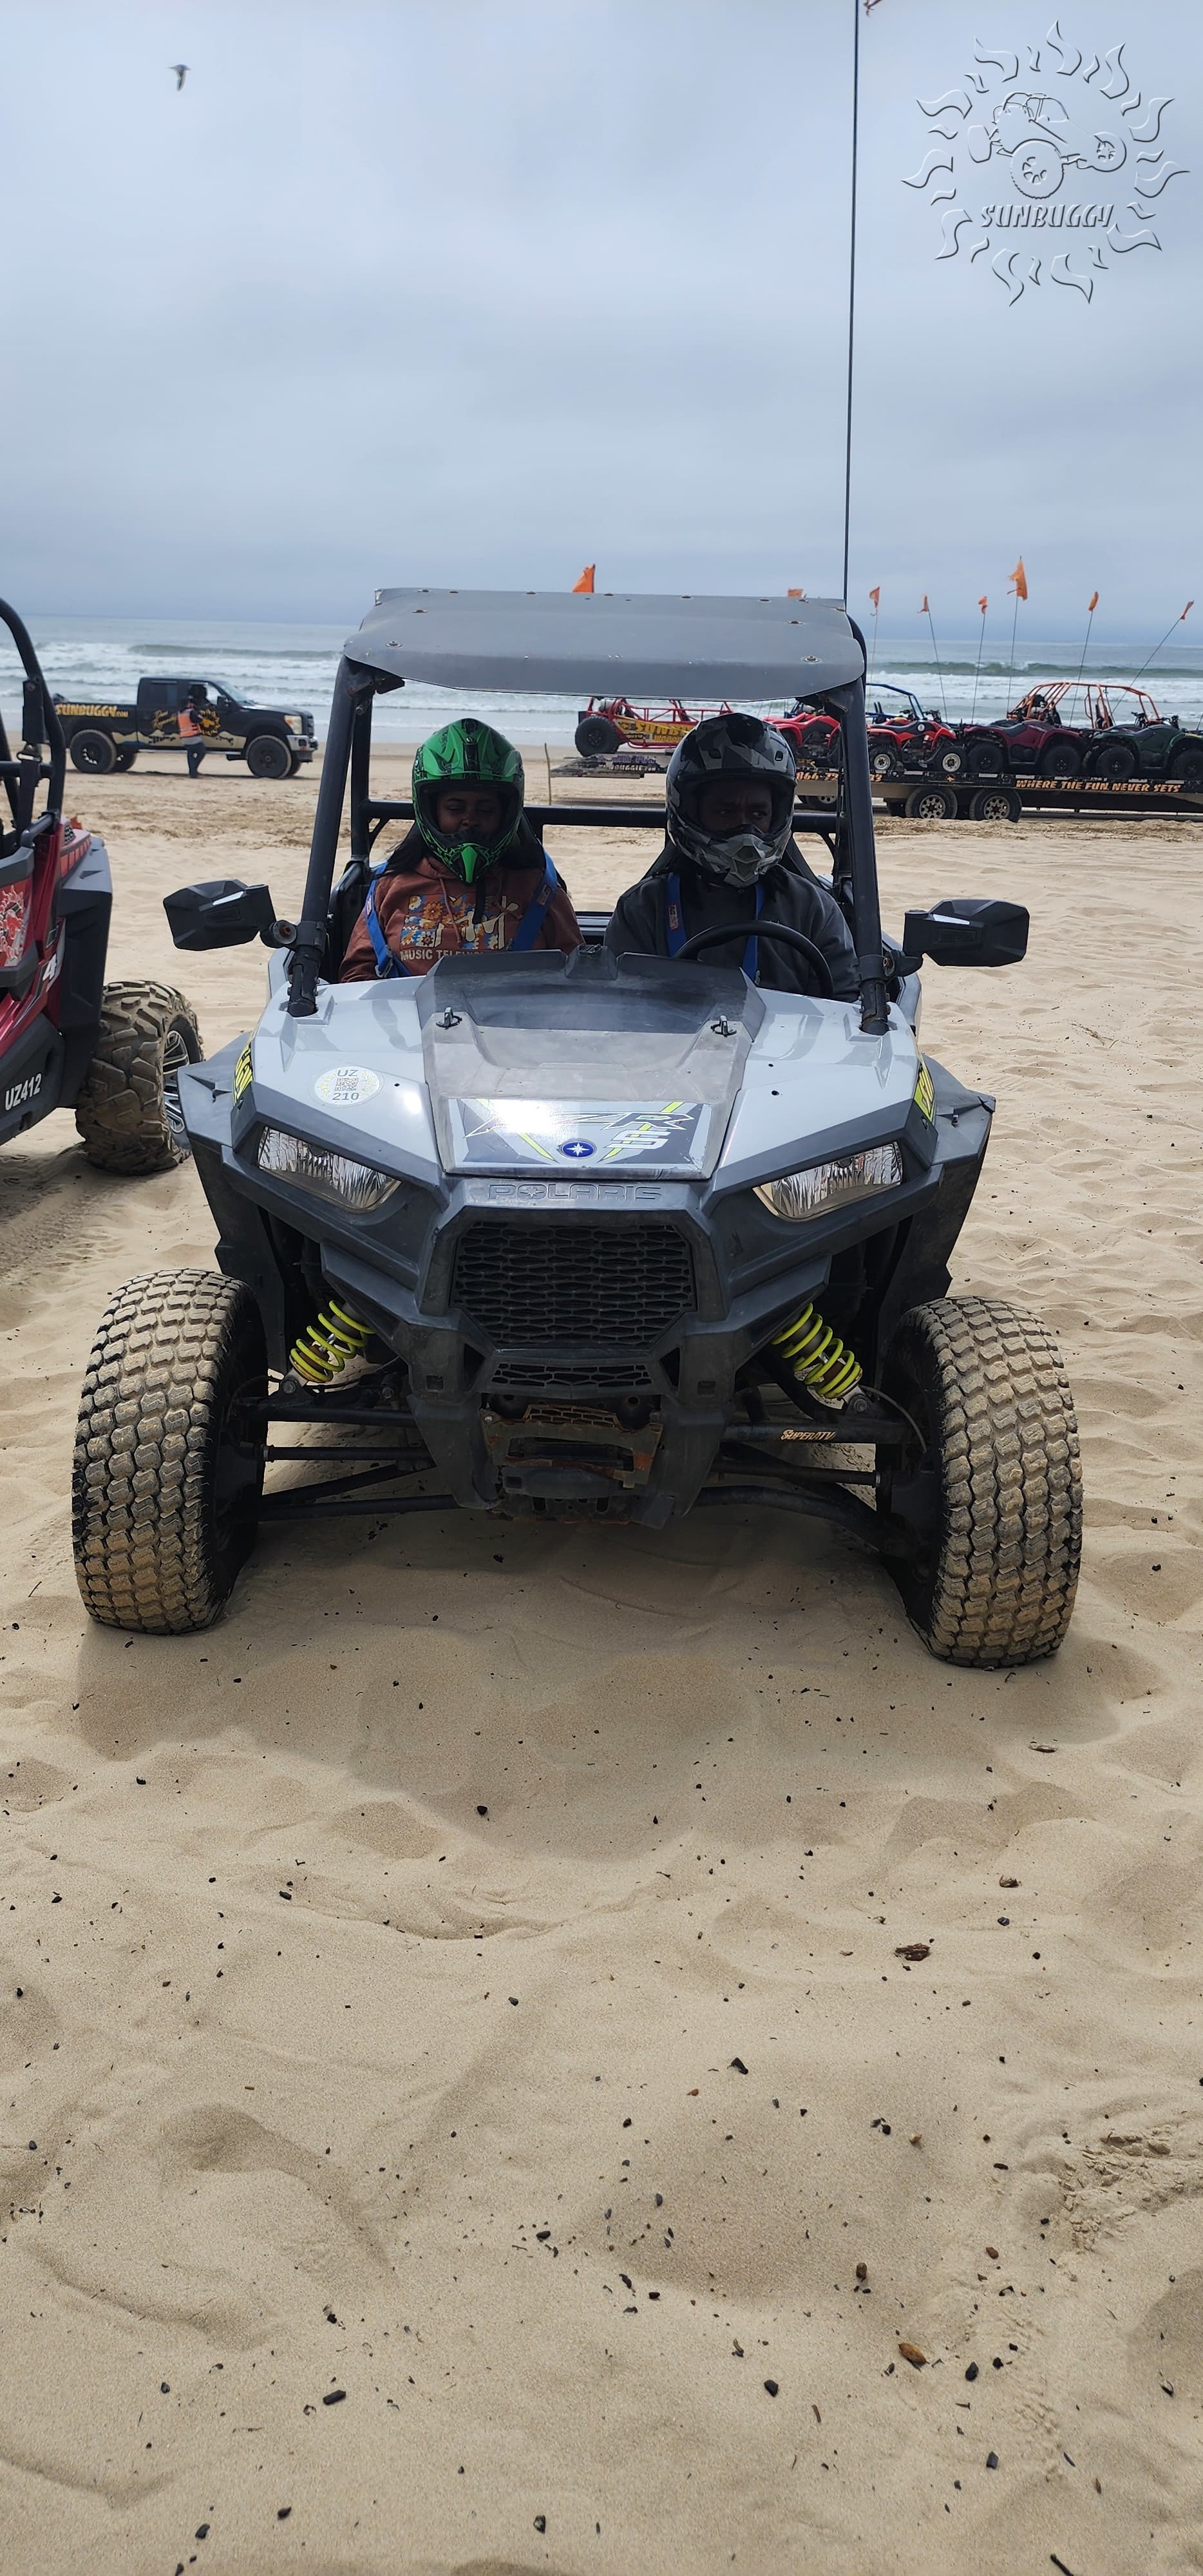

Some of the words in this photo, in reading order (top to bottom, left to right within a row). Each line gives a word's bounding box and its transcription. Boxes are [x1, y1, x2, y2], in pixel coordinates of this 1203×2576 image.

[1016, 779, 1057, 789] WHERE
[1061, 781, 1083, 790] THE
[1085, 782, 1108, 791] FUN
[1112, 782, 1150, 792] NEVER
[1153, 784, 1181, 793] SETS
[400, 949, 433, 961] MUSIC
[5, 1073, 43, 1111] UZ412
[332, 1092, 359, 1101] 210
[488, 1183, 662, 1202] POLARIS
